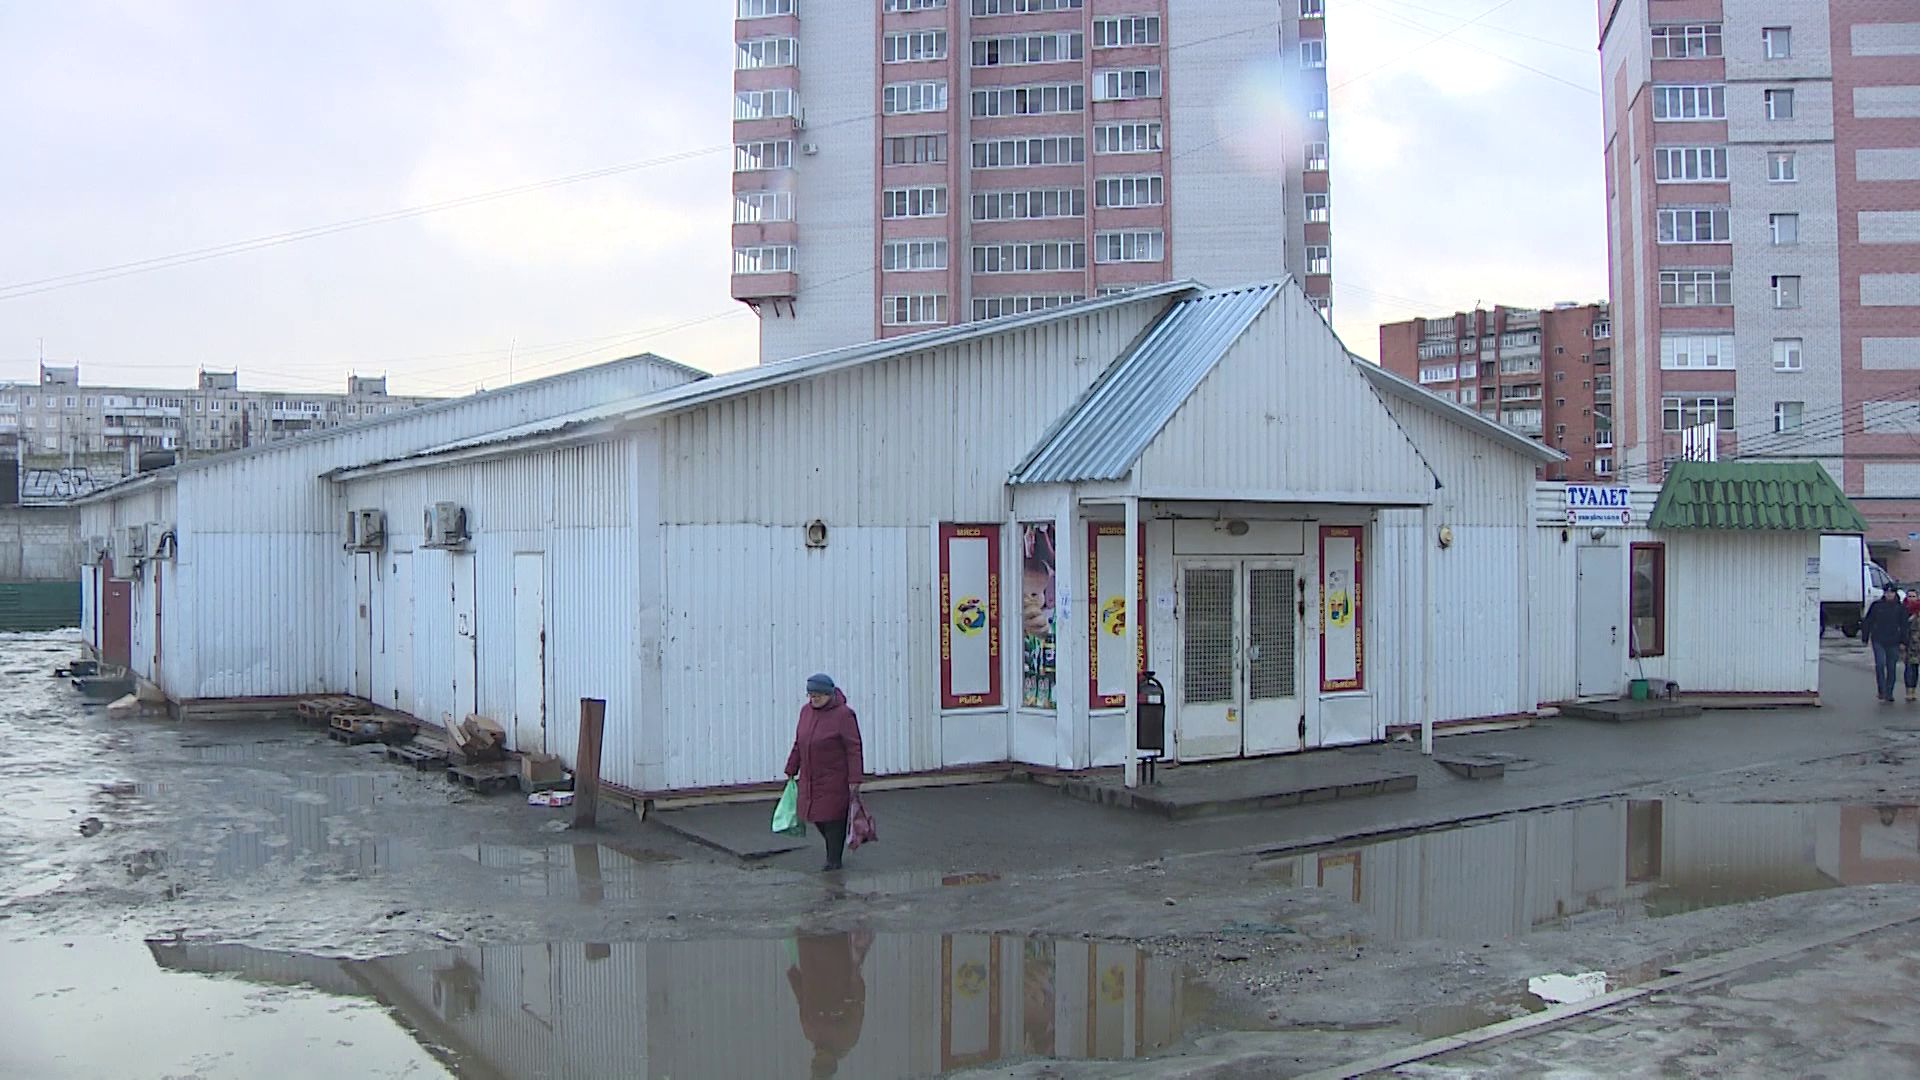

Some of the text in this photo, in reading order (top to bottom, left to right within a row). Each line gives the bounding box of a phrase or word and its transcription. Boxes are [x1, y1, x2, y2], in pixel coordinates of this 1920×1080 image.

[1567, 487, 1628, 506] ТУАЛЕТ
[957, 528, 981, 537] МЯСО
[958, 695, 983, 704] РЫБА
